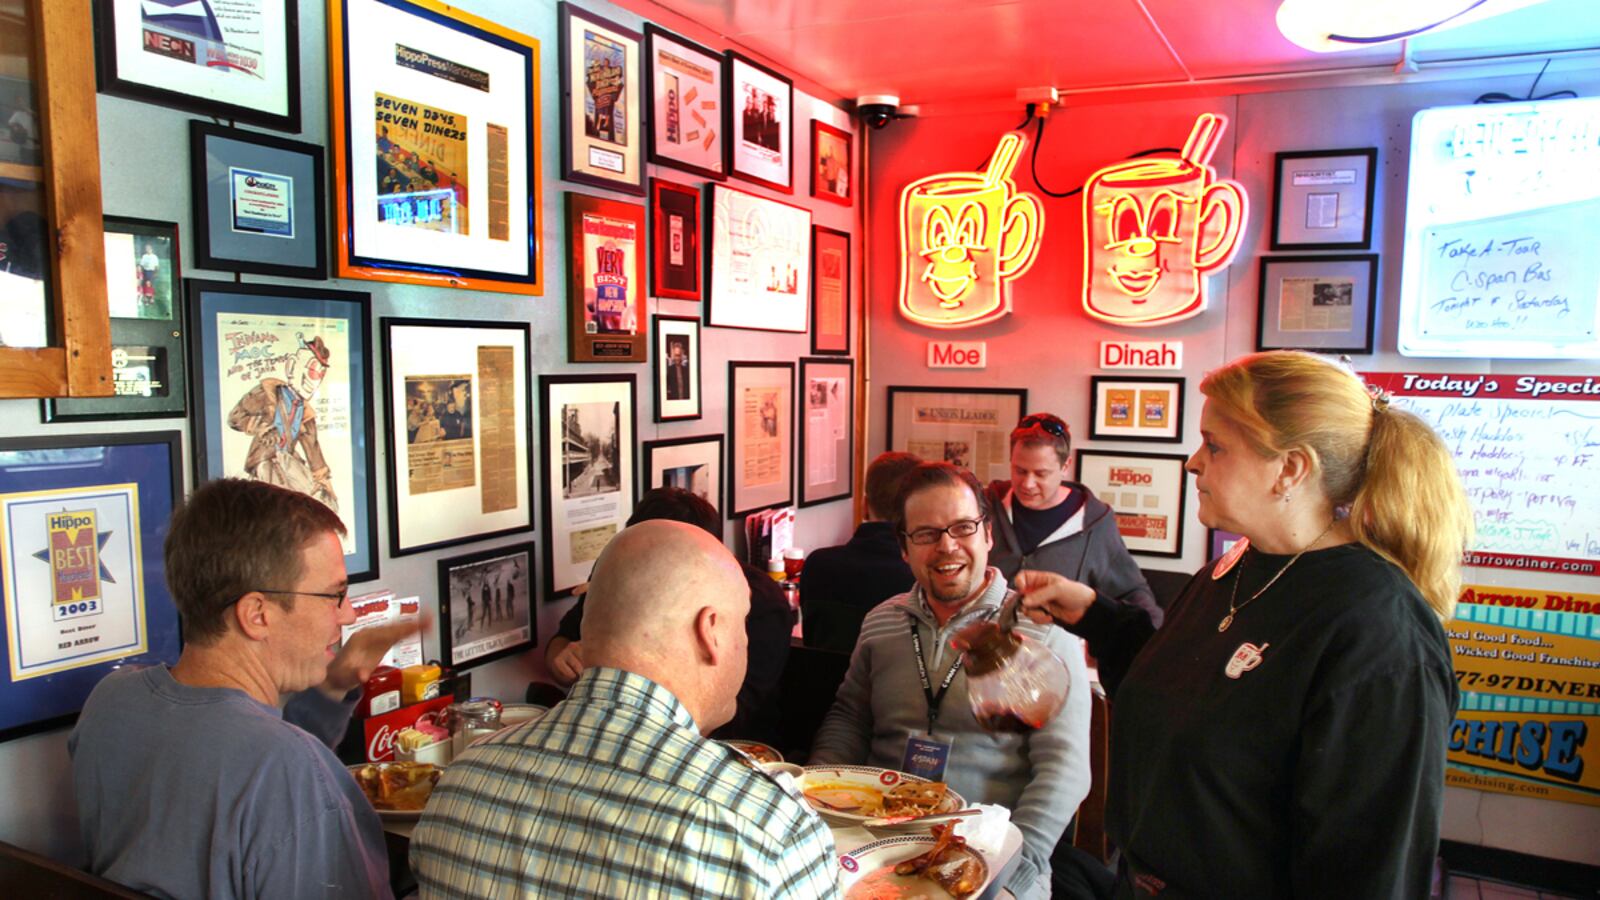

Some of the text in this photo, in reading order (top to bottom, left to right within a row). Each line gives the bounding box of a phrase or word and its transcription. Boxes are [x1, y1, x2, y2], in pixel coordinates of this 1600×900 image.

[597, 274, 626, 286] BEST
[933, 344, 980, 365] Moe
[1104, 344, 1176, 366] Dinah
[1403, 374, 1499, 397] Today's
[1110, 468, 1152, 485] Hippo
[51, 516, 91, 530] Hippo
[56, 545, 93, 570] BEST
[1463, 553, 1594, 572] darrowdiner.com
[59, 601, 97, 616] 2003
[1457, 588, 1600, 615] Arrow Dine
[1445, 628, 1554, 648] cked Good Food...
[1455, 645, 1498, 658] Wicked
[1501, 649, 1535, 662] Good
[1455, 670, 1600, 698] 77-97DINER
[1448, 719, 1587, 783] CHISE
[1446, 774, 1550, 795] ranchising.com
